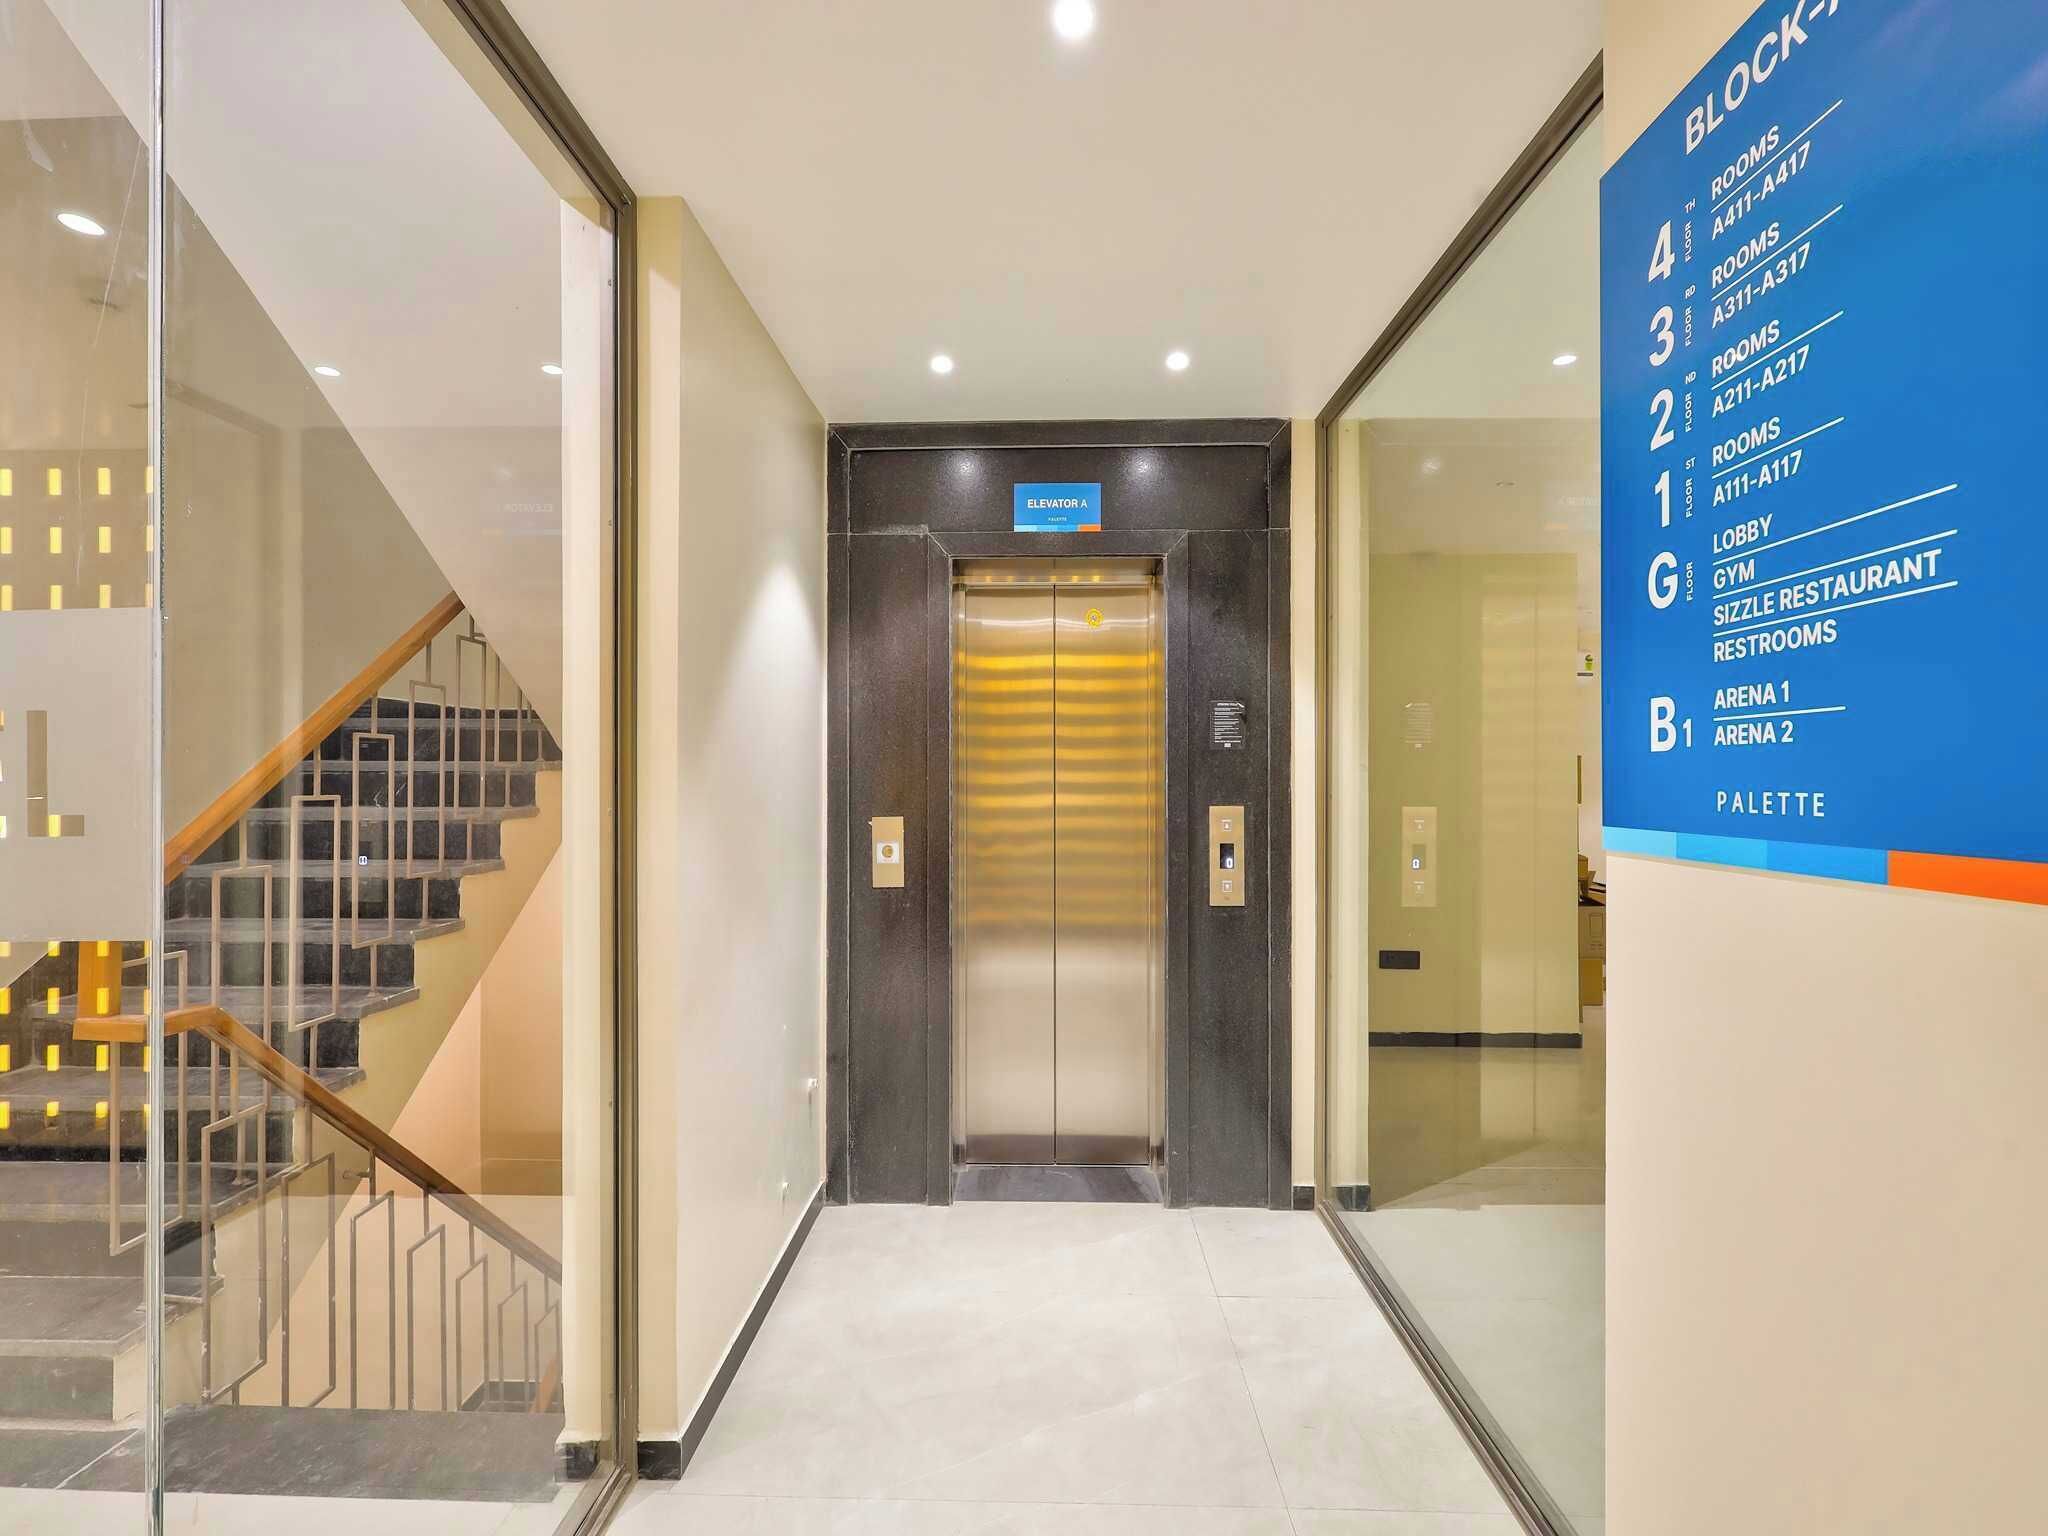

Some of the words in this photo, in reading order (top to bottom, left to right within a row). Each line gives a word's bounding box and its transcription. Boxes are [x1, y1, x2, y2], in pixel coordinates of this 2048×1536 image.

[1712, 125, 1780, 201] ROOMS
[1685, 198, 1696, 214] TH
[1712, 140, 1811, 241] A411-A417
[1647, 219, 1676, 283] 4
[1684, 221, 1692, 261] FLOOR
[1712, 222, 1780, 289] ROOMS
[1685, 284, 1696, 300] RD
[1712, 241, 1811, 329] A311-A317
[1648, 305, 1675, 367] 3
[1684, 305, 1692, 347] FLOOR
[1712, 319, 1780, 379] ROOMS
[1685, 371, 1697, 385] ND
[1712, 344, 1810, 418] A211-A217
[1650, 388, 1675, 452] 2
[1684, 392, 1692, 433] FLOOR
[1712, 416, 1781, 467] ROOMS
[1027, 499, 1078, 508] ELEVATOR
[1081, 499, 1088, 508] A
[1654, 470, 1670, 528] 1
[1685, 456, 1696, 470] ST
[1712, 449, 1802, 507] A111-A117
[1713, 513, 1773, 554] LOBBY
[1647, 551, 1679, 609] G
[1686, 561, 1694, 601] FLOOR
[1713, 558, 1755, 589] GYM
[1713, 591, 1775, 626] SIZZLE
[1779, 548, 1942, 611] RESTAURANT
[1713, 618, 1837, 663] RESTROOMS
[1713, 682, 1777, 710] ARENA
[1781, 680, 1791, 704] 1
[1650, 696, 1677, 753] B
[1682, 718, 1692, 748] 1
[1714, 721, 1777, 746] ARENA
[1781, 720, 1794, 743] 2
[1717, 791, 1825, 817] PALETTE
[1226, 857, 1233, 869] 0
